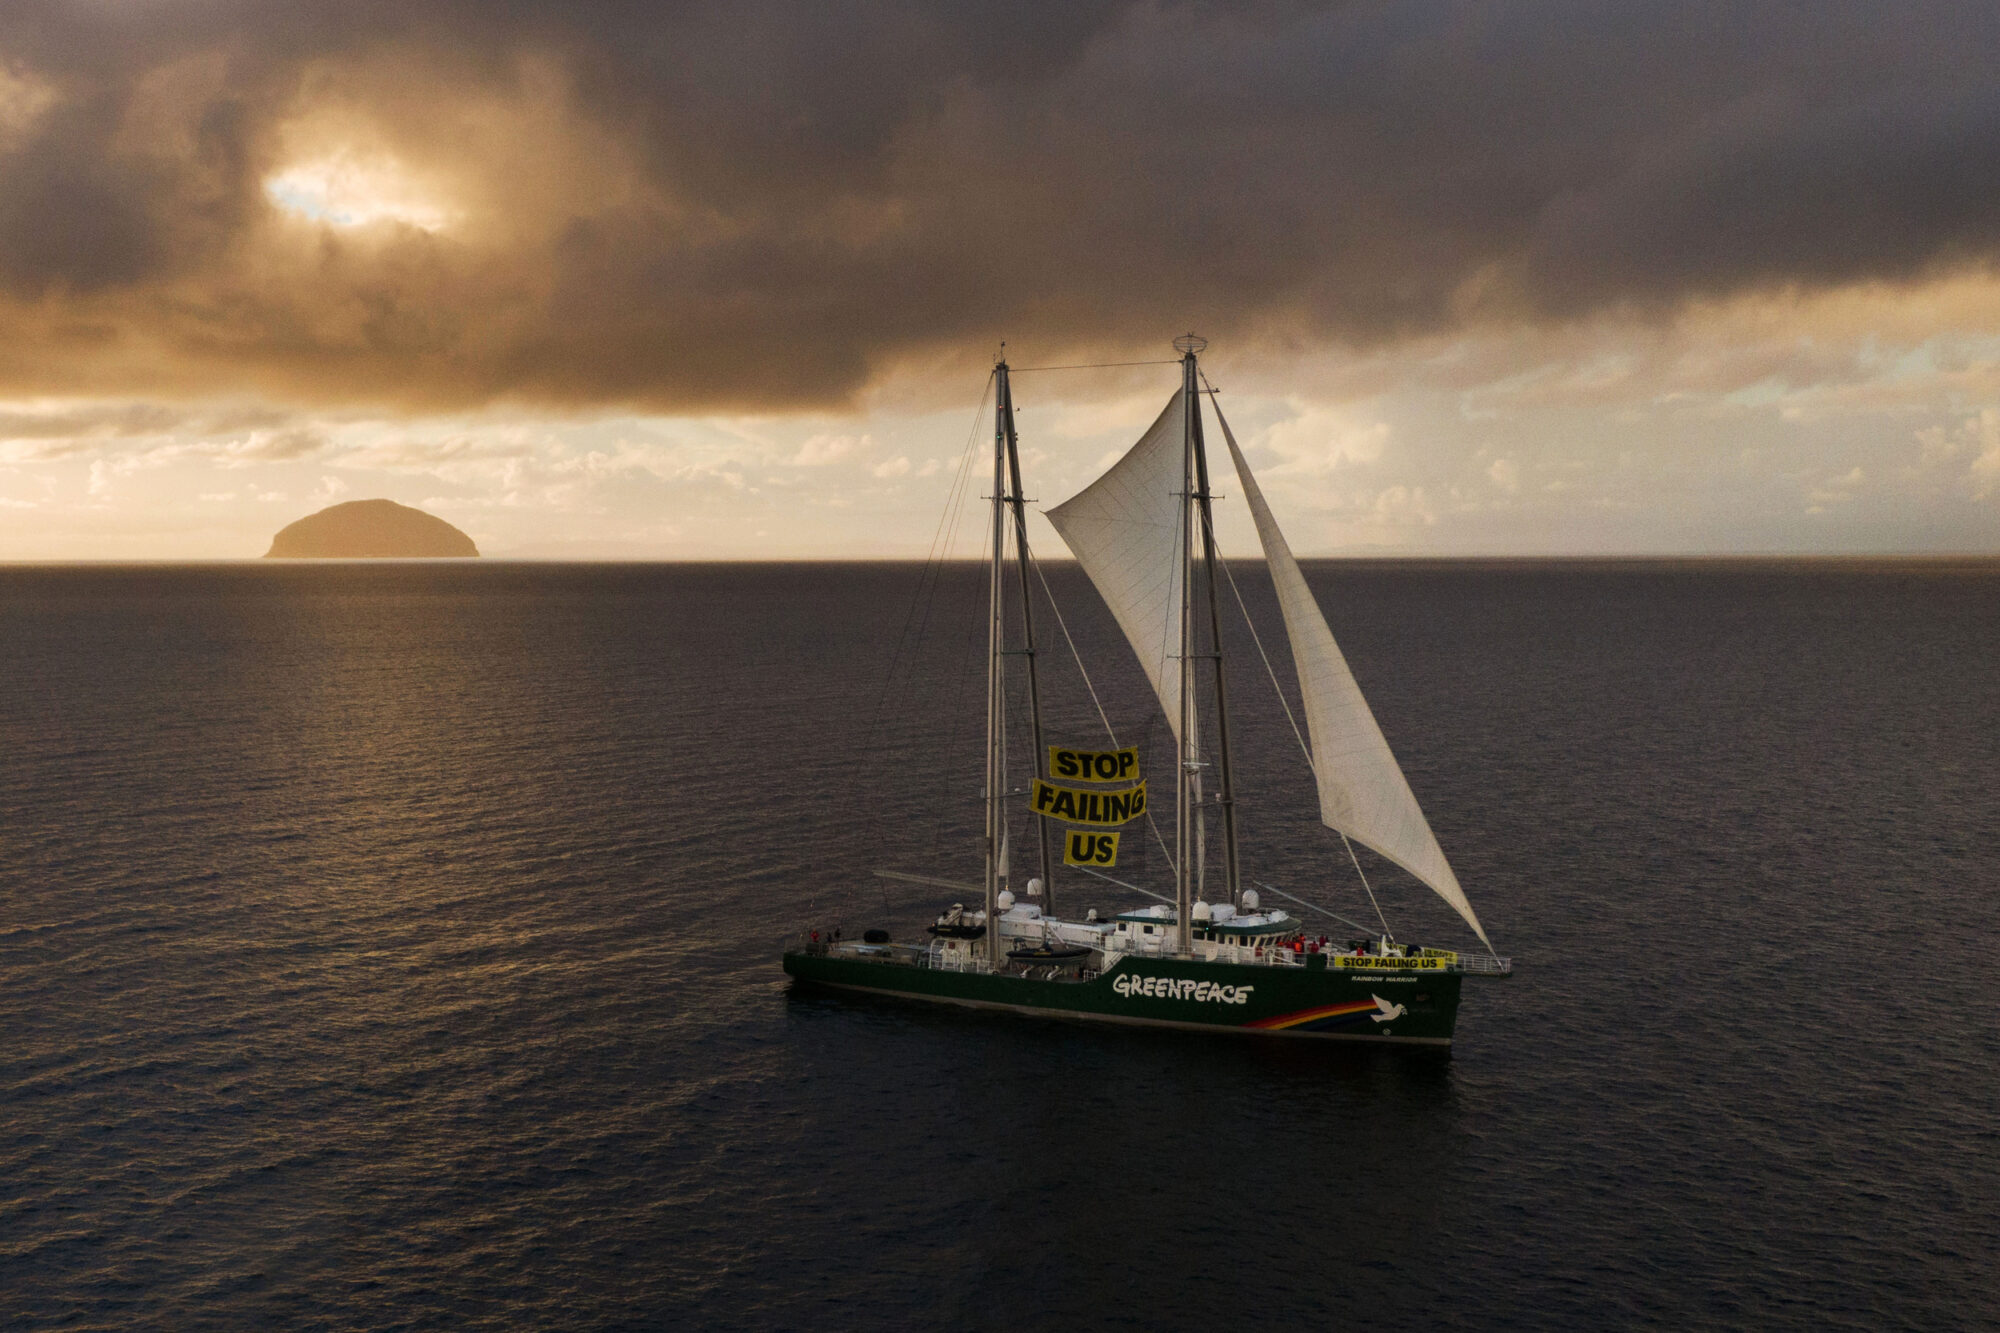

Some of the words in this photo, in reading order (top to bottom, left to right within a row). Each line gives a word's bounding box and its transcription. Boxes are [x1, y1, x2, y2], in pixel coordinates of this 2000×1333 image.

[1057, 751, 1134, 779] STOP
[1038, 784, 1144, 822] FAILING
[1072, 835, 1113, 863] US
[1343, 957, 1372, 967] STOP
[1375, 958, 1418, 968] FAILING
[1421, 959, 1437, 968] US
[1112, 973, 1255, 1005] GREENPEACE
